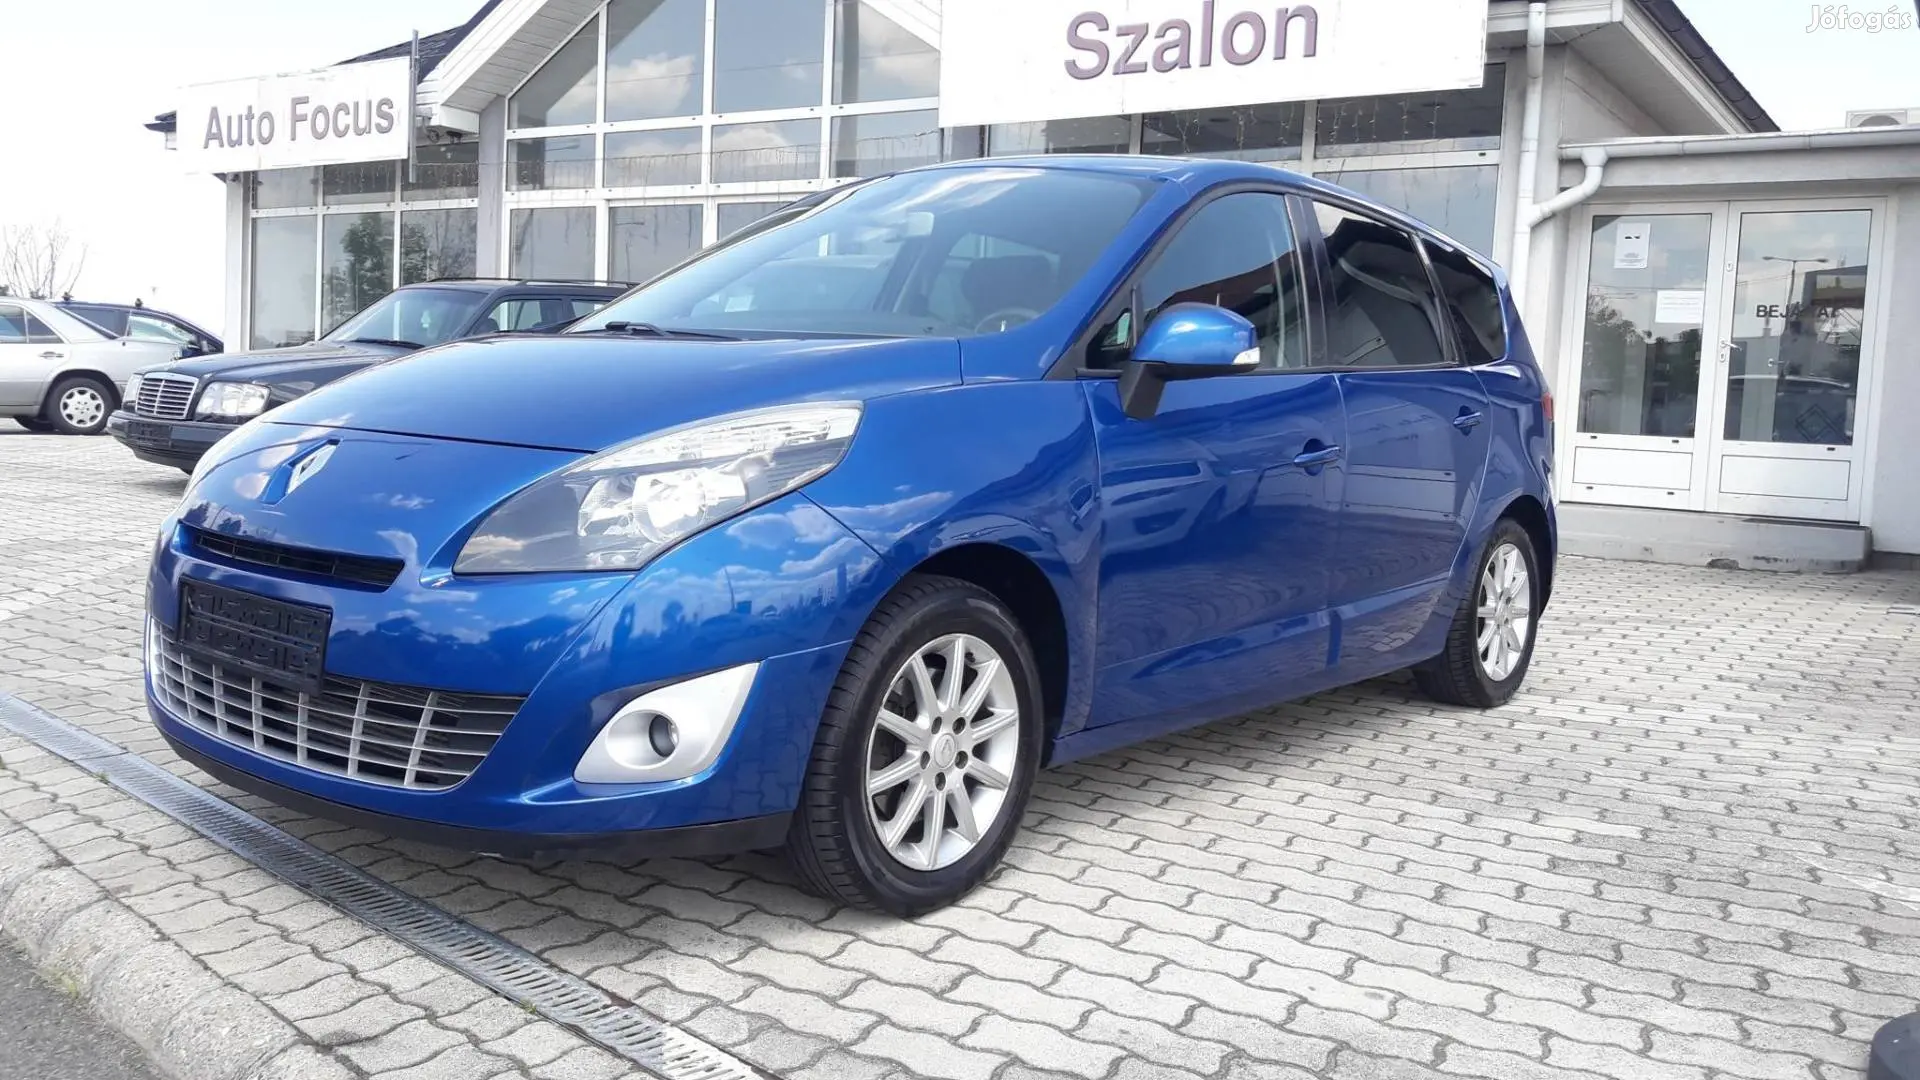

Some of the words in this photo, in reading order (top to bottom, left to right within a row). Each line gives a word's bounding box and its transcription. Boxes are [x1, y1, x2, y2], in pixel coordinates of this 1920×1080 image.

[1064, 0, 1319, 80] Szalon
[203, 106, 275, 149] Auto
[290, 96, 394, 141] Focus
[1756, 301, 1841, 318] BEJÁA
